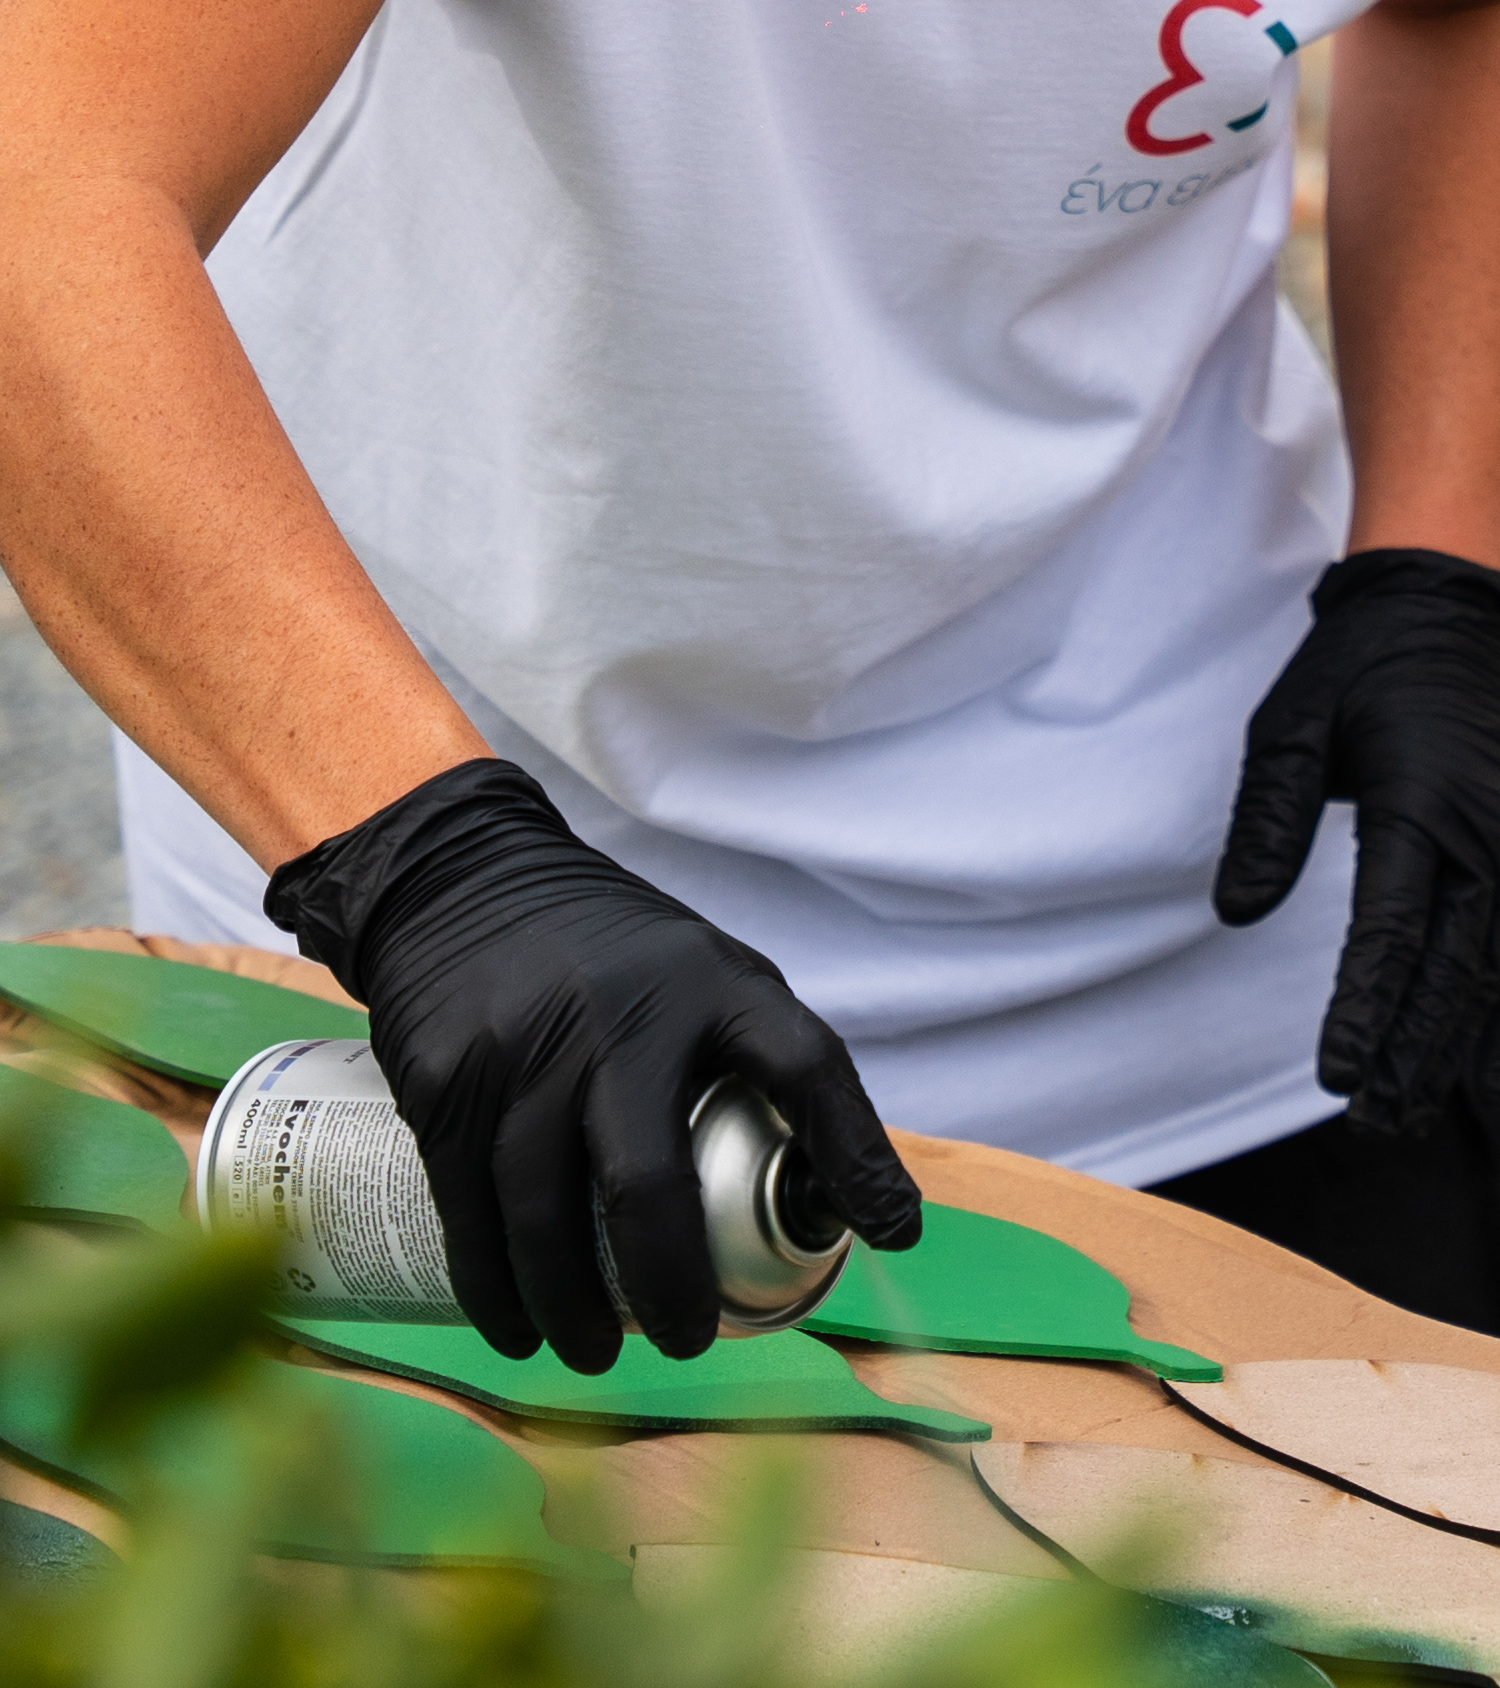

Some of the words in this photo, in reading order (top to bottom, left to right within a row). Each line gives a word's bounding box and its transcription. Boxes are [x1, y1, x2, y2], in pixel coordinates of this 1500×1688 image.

[237, 1098, 261, 1149] 400ml
[233, 1160, 243, 1180] 520
[272, 1100, 309, 1229] Evochem
